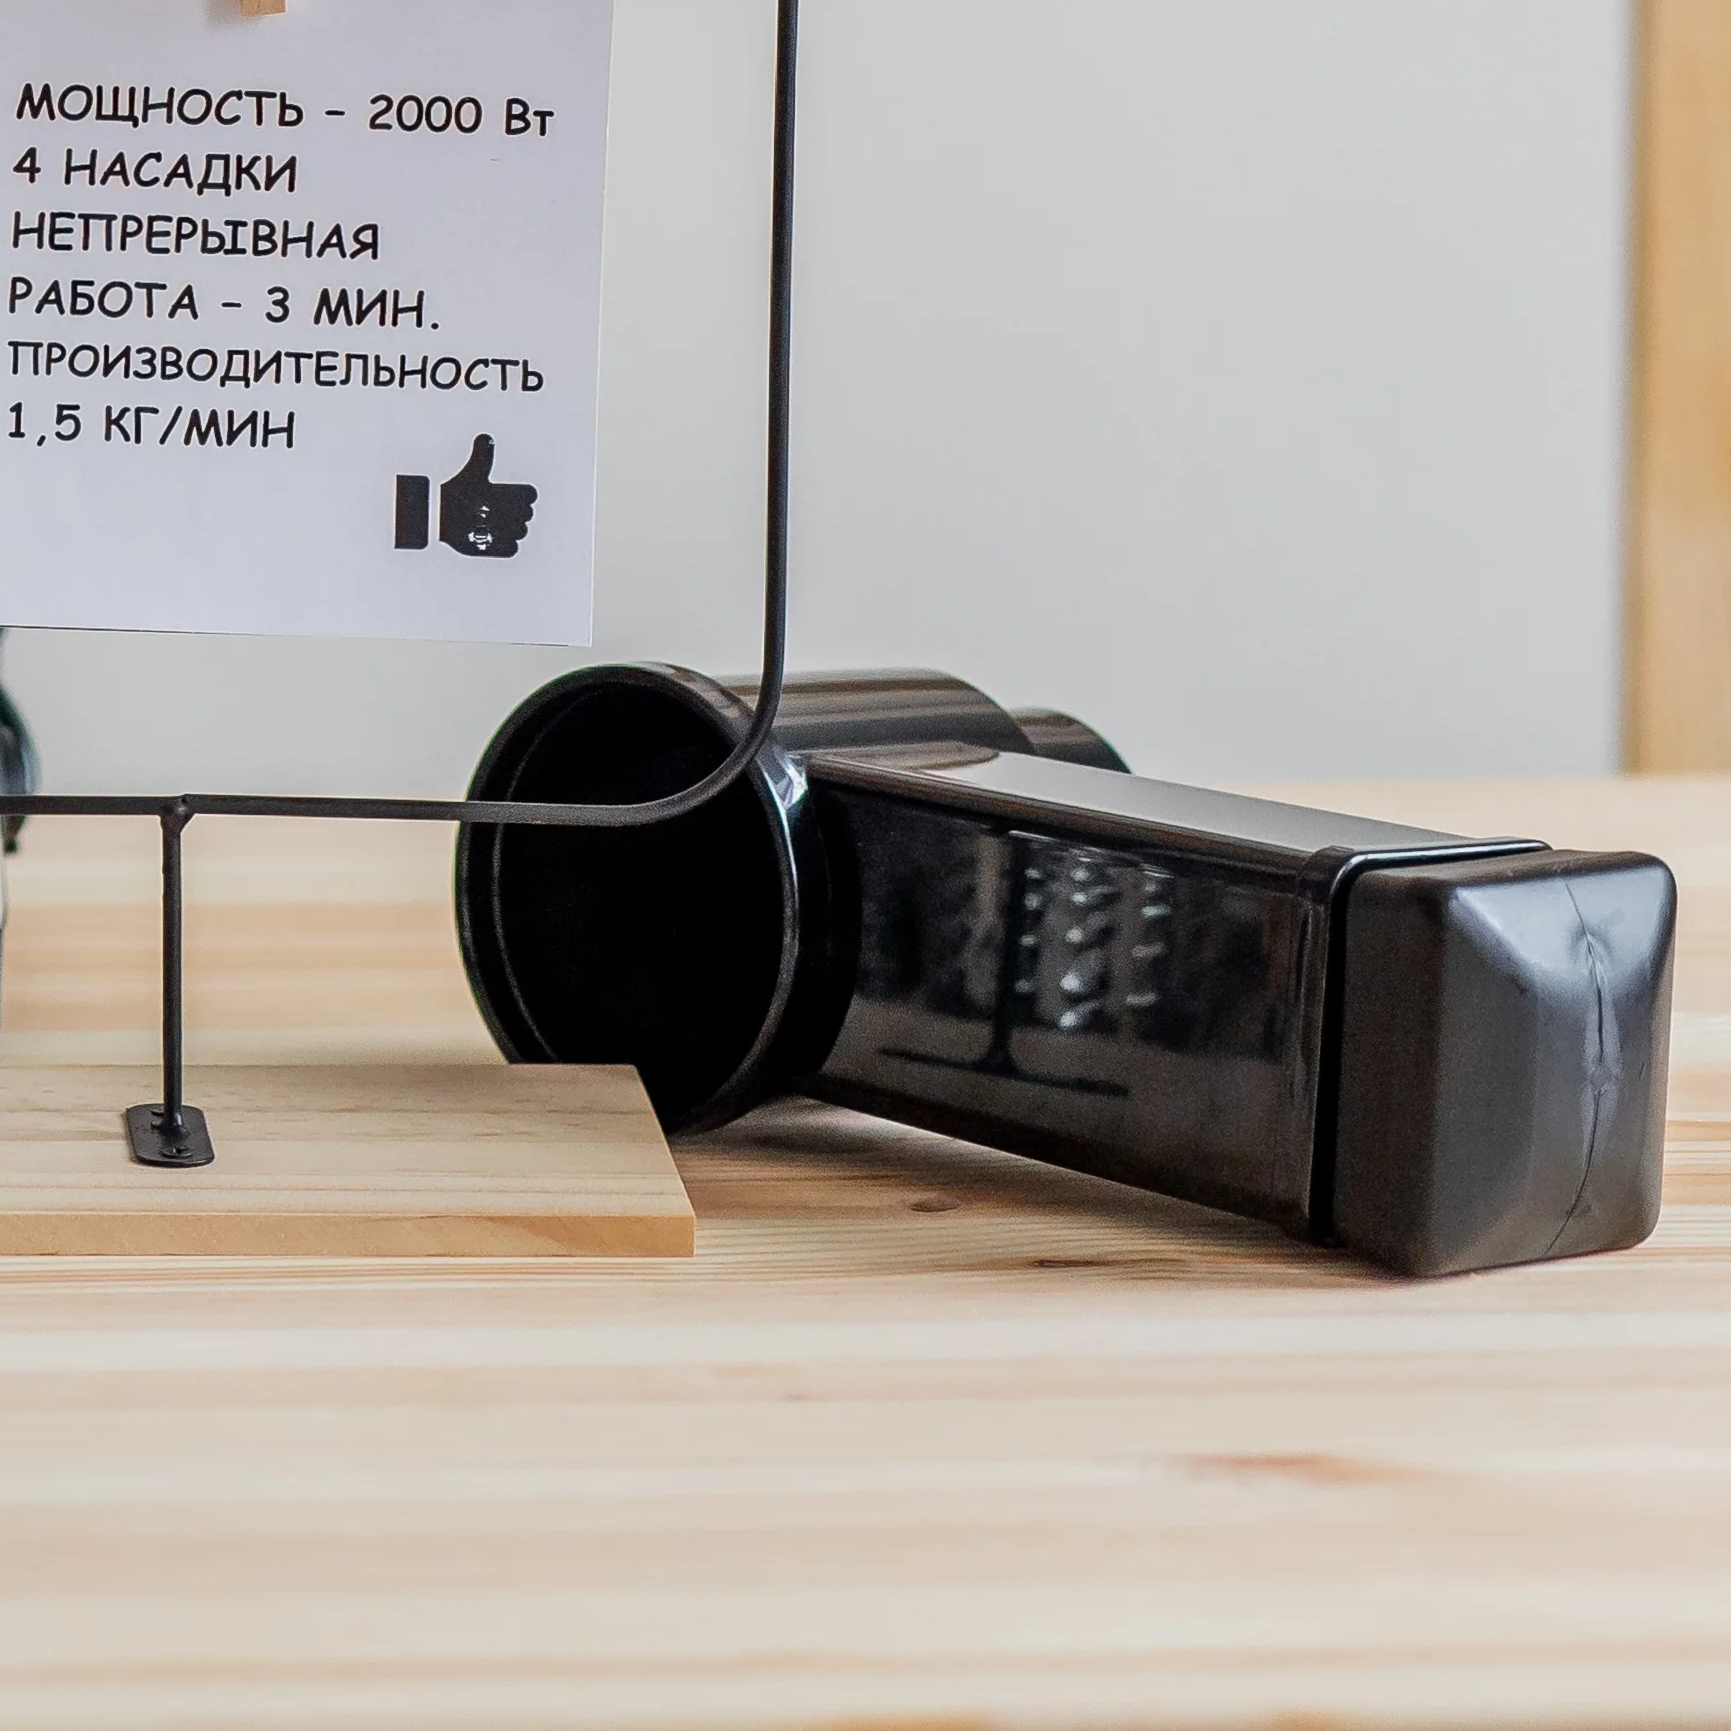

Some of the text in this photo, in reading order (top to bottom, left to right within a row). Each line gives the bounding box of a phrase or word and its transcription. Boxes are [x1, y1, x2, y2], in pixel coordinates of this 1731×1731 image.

[15, 82, 305, 130] МОЩНОСТЬ
[368, 94, 484, 135] 2000
[503, 97, 556, 138] Вт
[11, 145, 298, 198] 4 НАСАДКИ
[11, 210, 380, 261] НЕПРЕРЫВНАЯ
[7, 275, 200, 322] РАБОТА
[264, 285, 291, 325] 3
[312, 286, 441, 331] МИН.
[7, 340, 545, 393] ПРОИЗВОДИТЕЛЬНОСТЬ
[7, 401, 296, 450] 1,5 КГ/МИН
